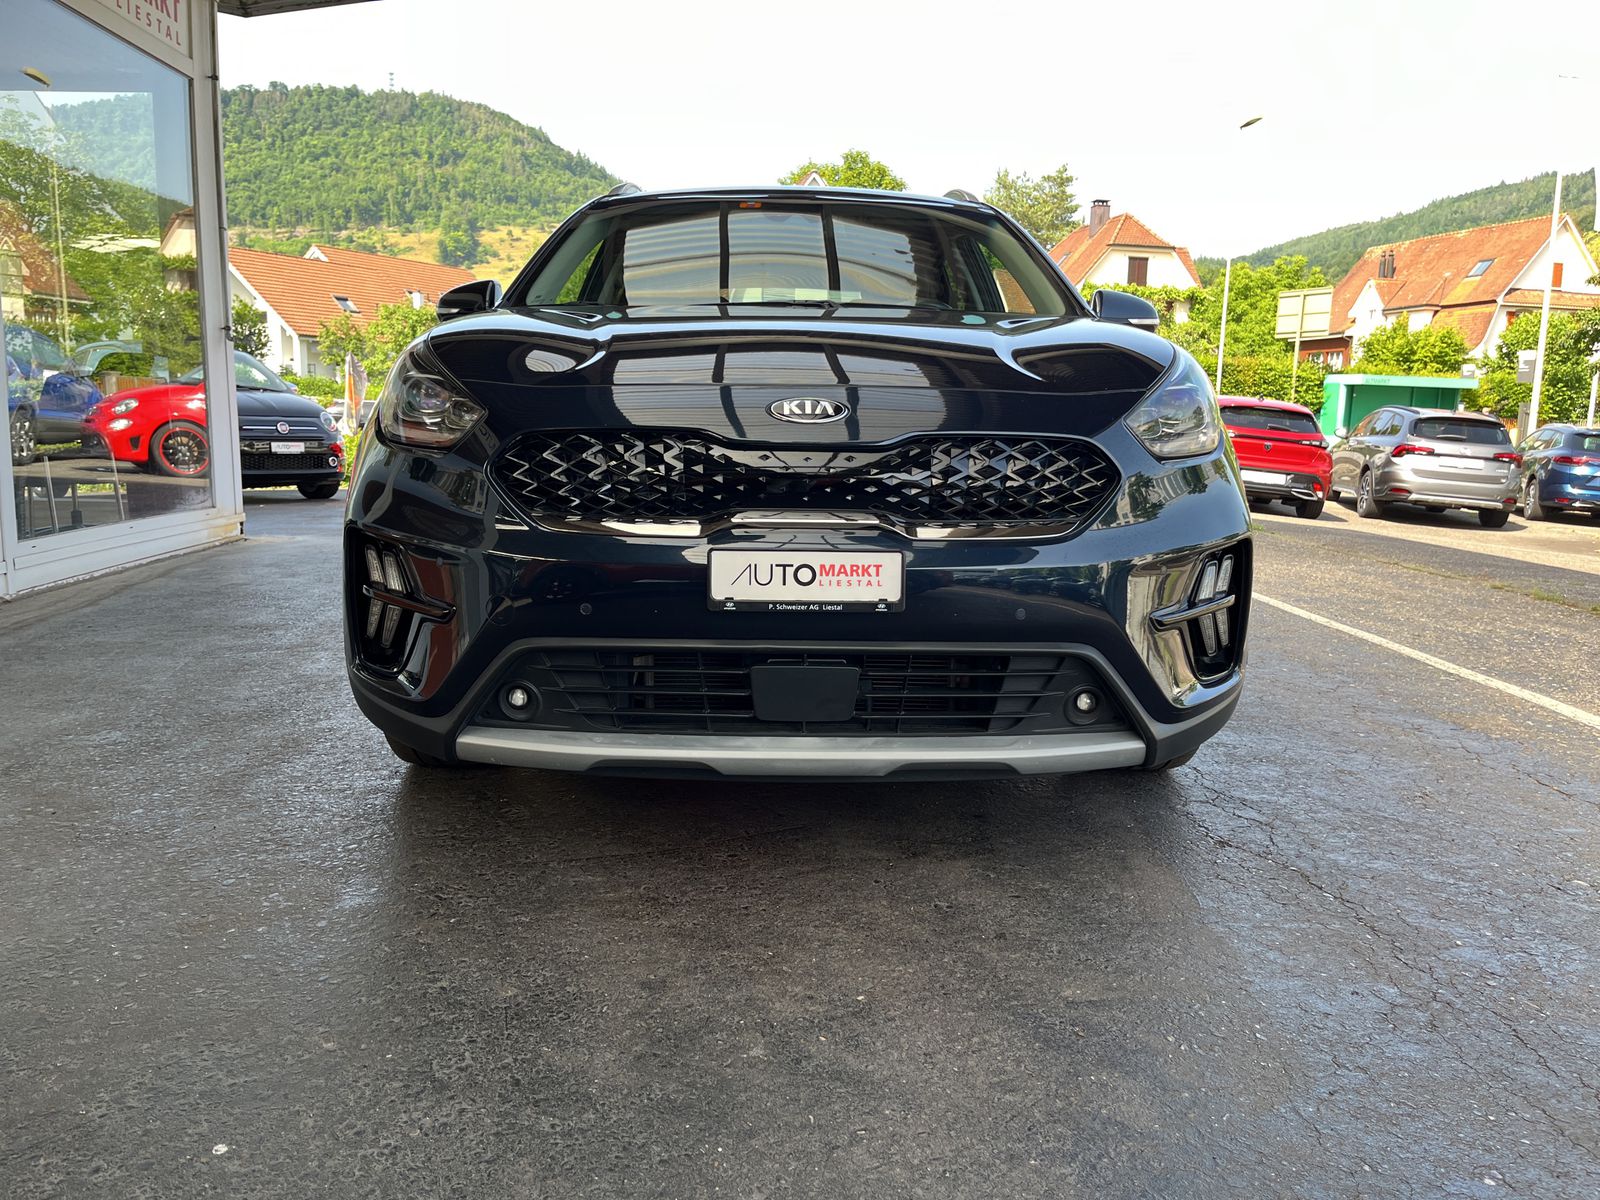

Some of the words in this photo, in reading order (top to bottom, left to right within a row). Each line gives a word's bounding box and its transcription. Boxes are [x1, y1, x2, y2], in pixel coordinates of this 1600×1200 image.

[783, 400, 835, 416] KIA
[819, 563, 883, 578] MARKT
[819, 579, 883, 587] LIESTAL
[768, 603, 775, 611] P.
[776, 603, 807, 611] Schweizer
[822, 603, 843, 611] Liestal
